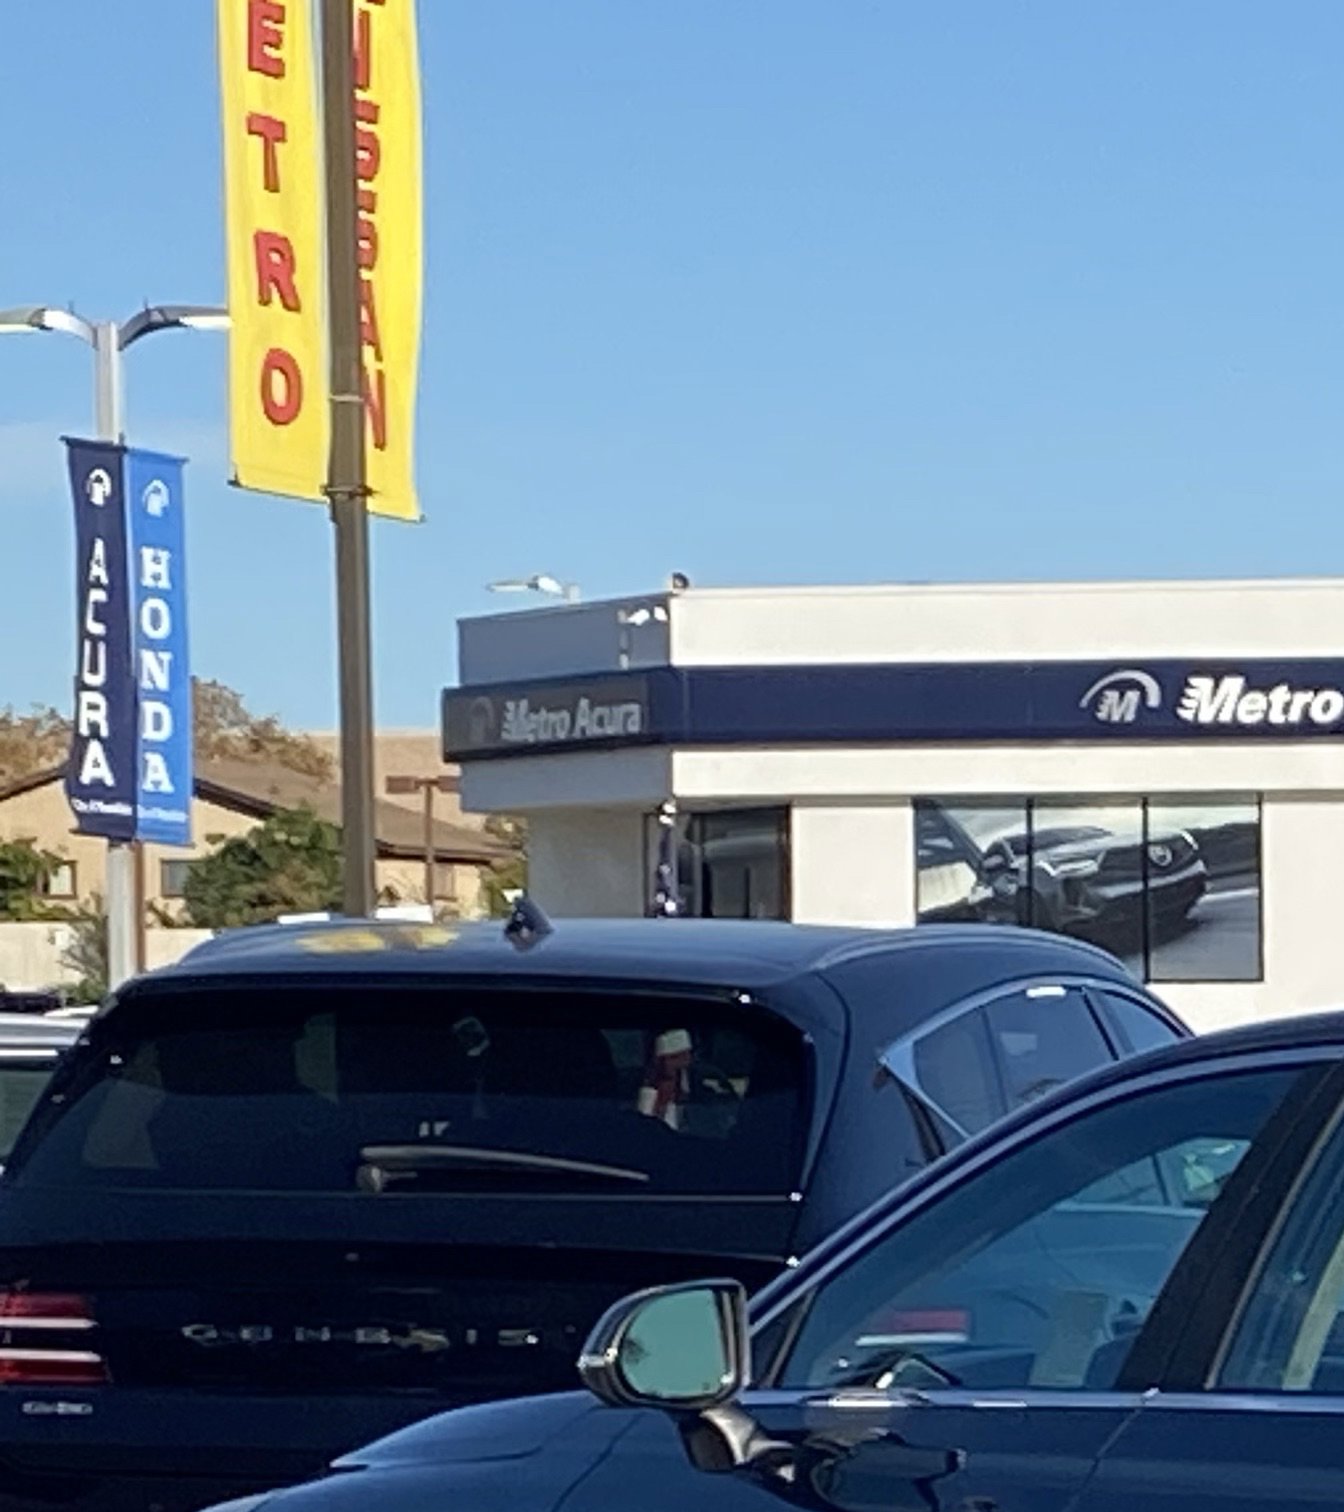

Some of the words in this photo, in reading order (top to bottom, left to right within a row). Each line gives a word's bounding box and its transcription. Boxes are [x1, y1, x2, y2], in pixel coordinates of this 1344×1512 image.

[352, 0, 389, 451] ISSAN
[78, 537, 115, 788] ACURA
[139, 546, 174, 794] HONDA
[501, 698, 571, 743] Metro
[572, 696, 642, 739] Acura
